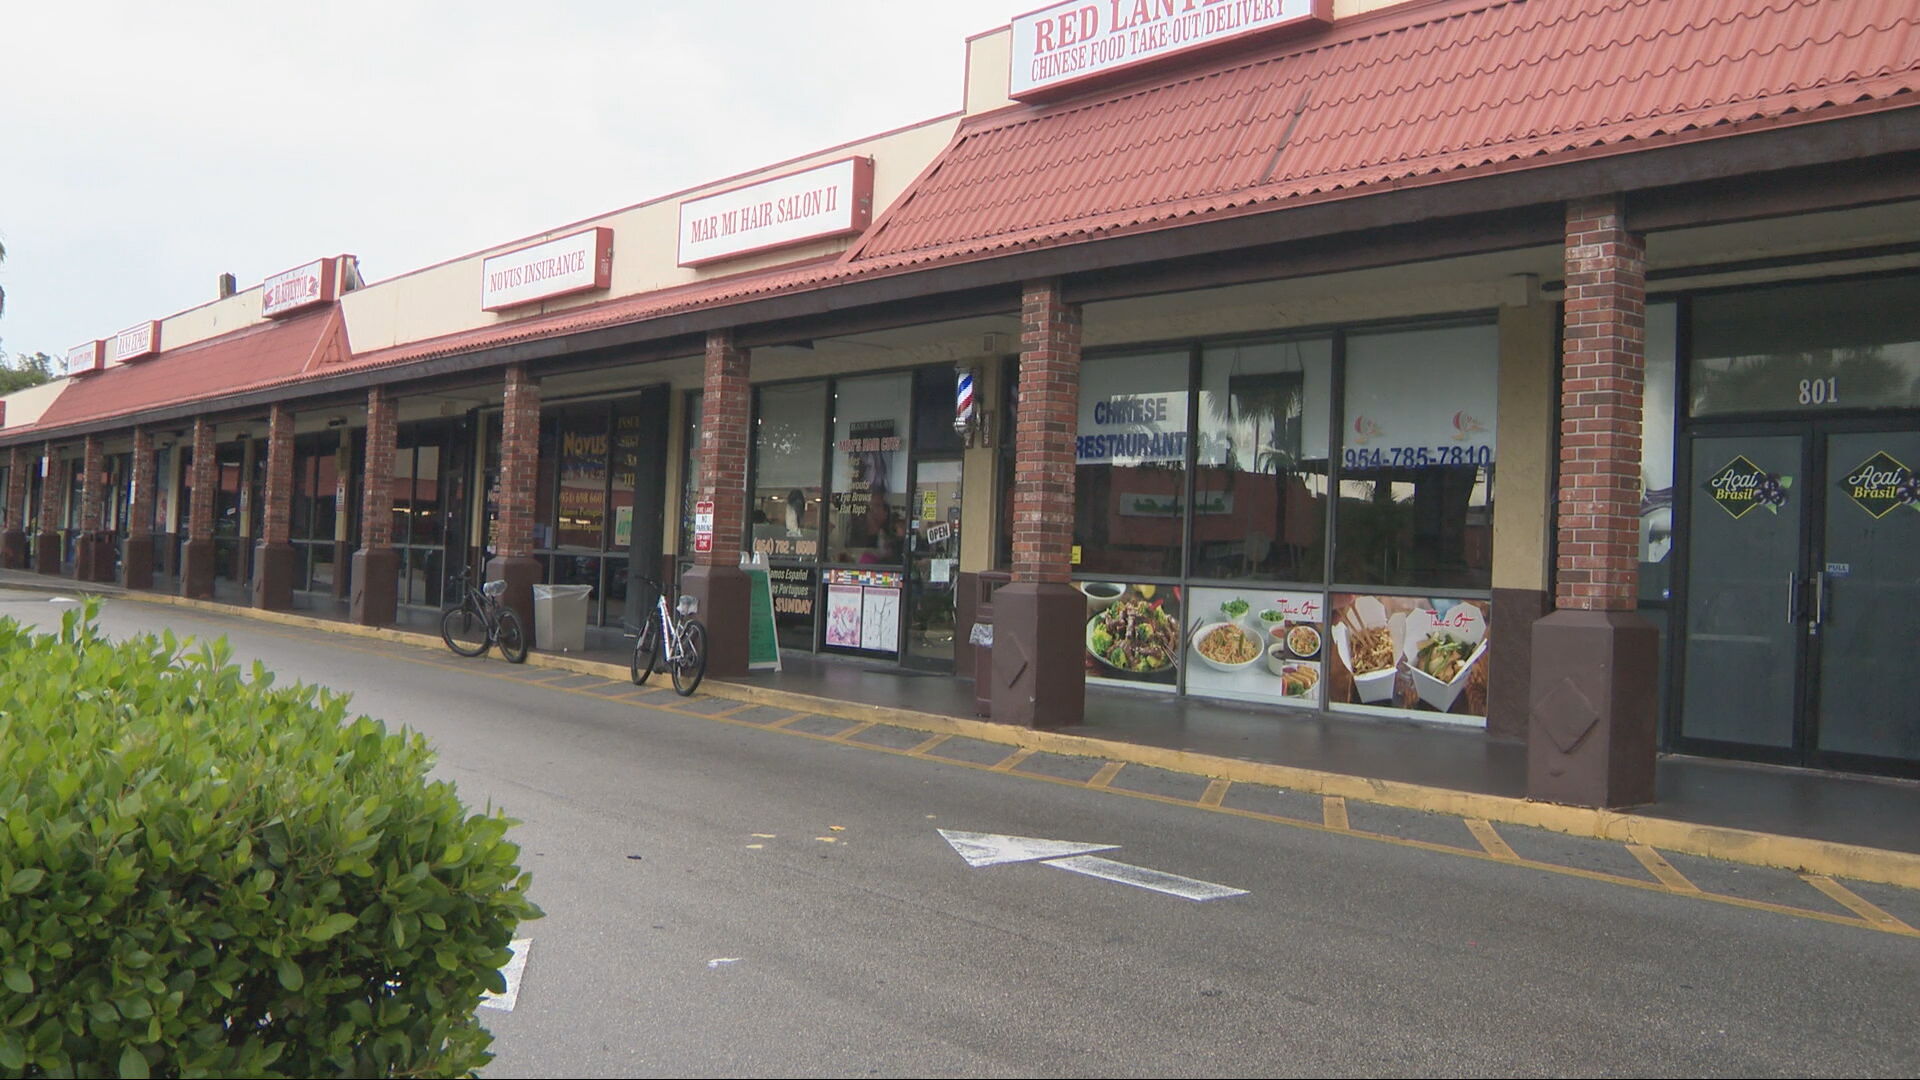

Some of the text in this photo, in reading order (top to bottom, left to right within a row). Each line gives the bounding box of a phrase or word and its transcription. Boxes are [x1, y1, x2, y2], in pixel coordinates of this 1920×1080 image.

[1032, 0, 1286, 82] CHINESE FOOD TAKE-OUT/DELIVERY
[1034, 0, 1224, 55] RED LAN
[691, 186, 838, 243] MAR MI HAIR SALON II
[490, 267, 522, 292] NOVUS
[524, 250, 586, 284] INSURANCE
[1798, 376, 1838, 404] 801
[1094, 397, 1168, 425] CHINESE
[1345, 445, 1490, 471] 954-785-7810
[1716, 489, 1753, 500] Brasil
[1853, 486, 1896, 499] Brasil
[929, 523, 948, 541] OPEN
[775, 597, 813, 614] SUNDAY
